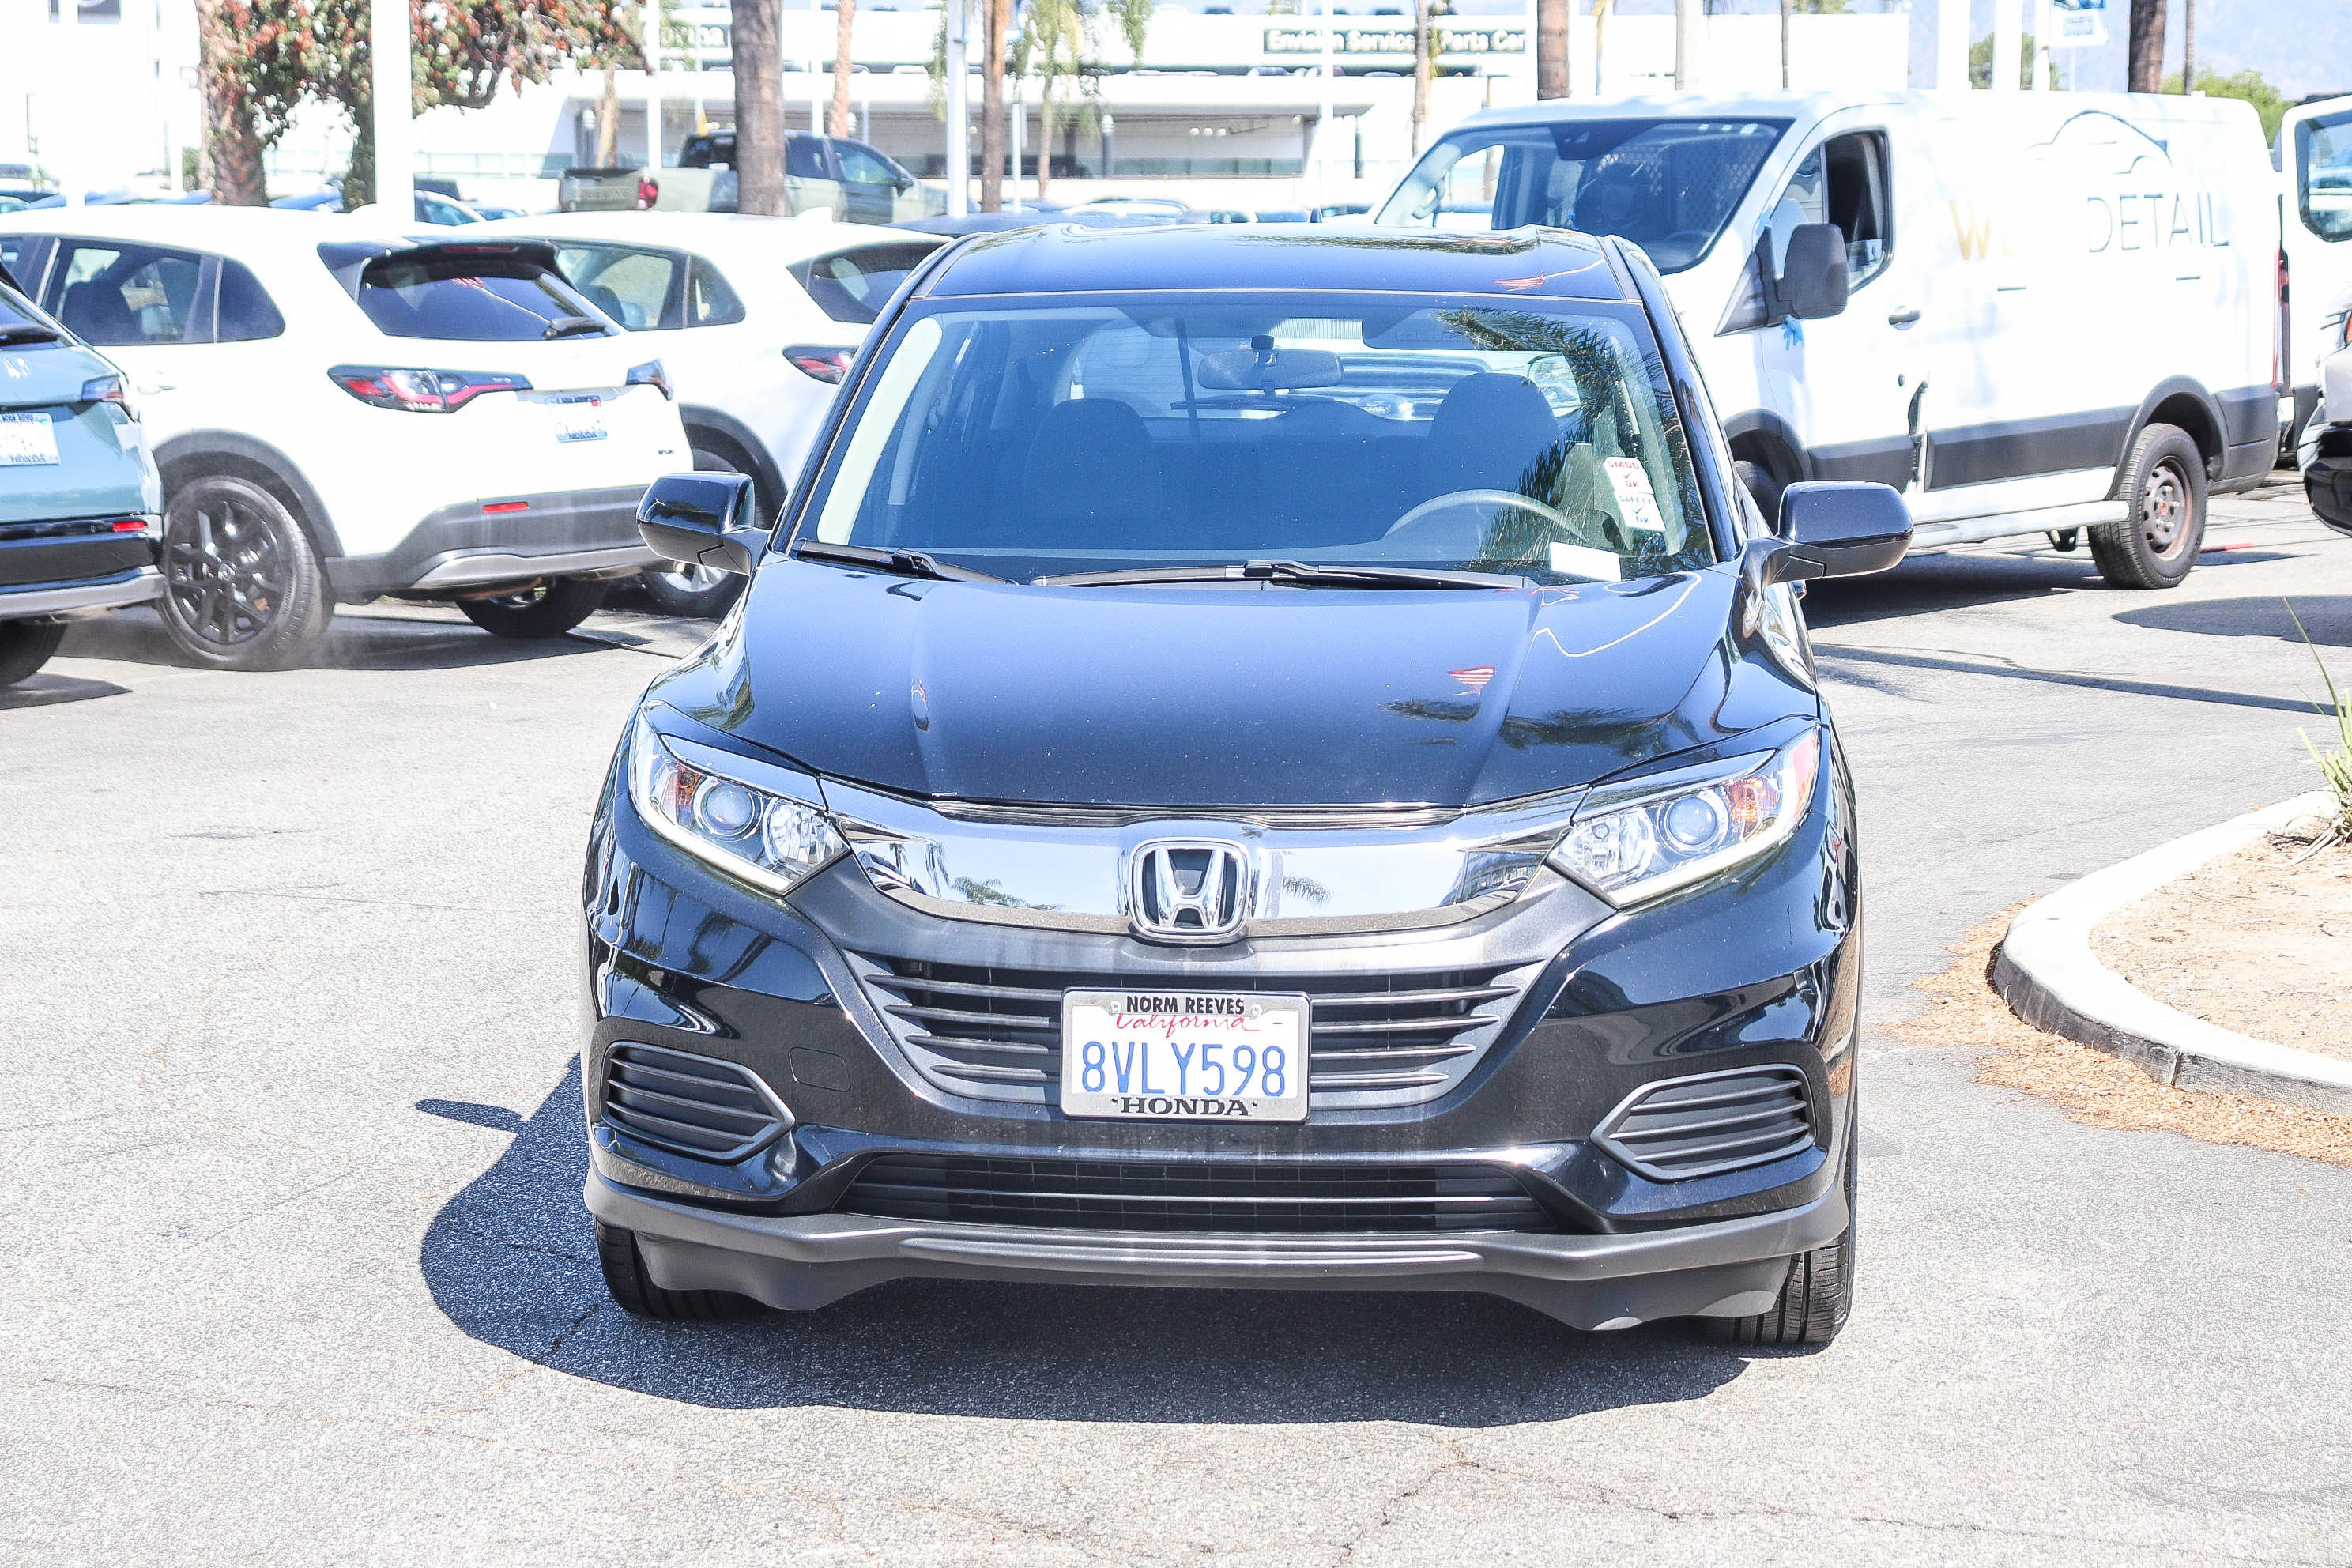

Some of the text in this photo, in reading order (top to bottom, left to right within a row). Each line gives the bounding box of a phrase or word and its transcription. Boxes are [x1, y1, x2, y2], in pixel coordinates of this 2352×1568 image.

[1268, 29, 1344, 51] Envisin
[1347, 29, 1415, 51] Service
[1440, 29, 1489, 51] Parts
[2087, 192, 2230, 253] DETAIL
[1126, 995, 1245, 1015] NORM REEVES
[1116, 1012, 1261, 1038] California
[1082, 1040, 1286, 1098] 8VLY598
[1120, 1096, 1253, 1116] HONDA
